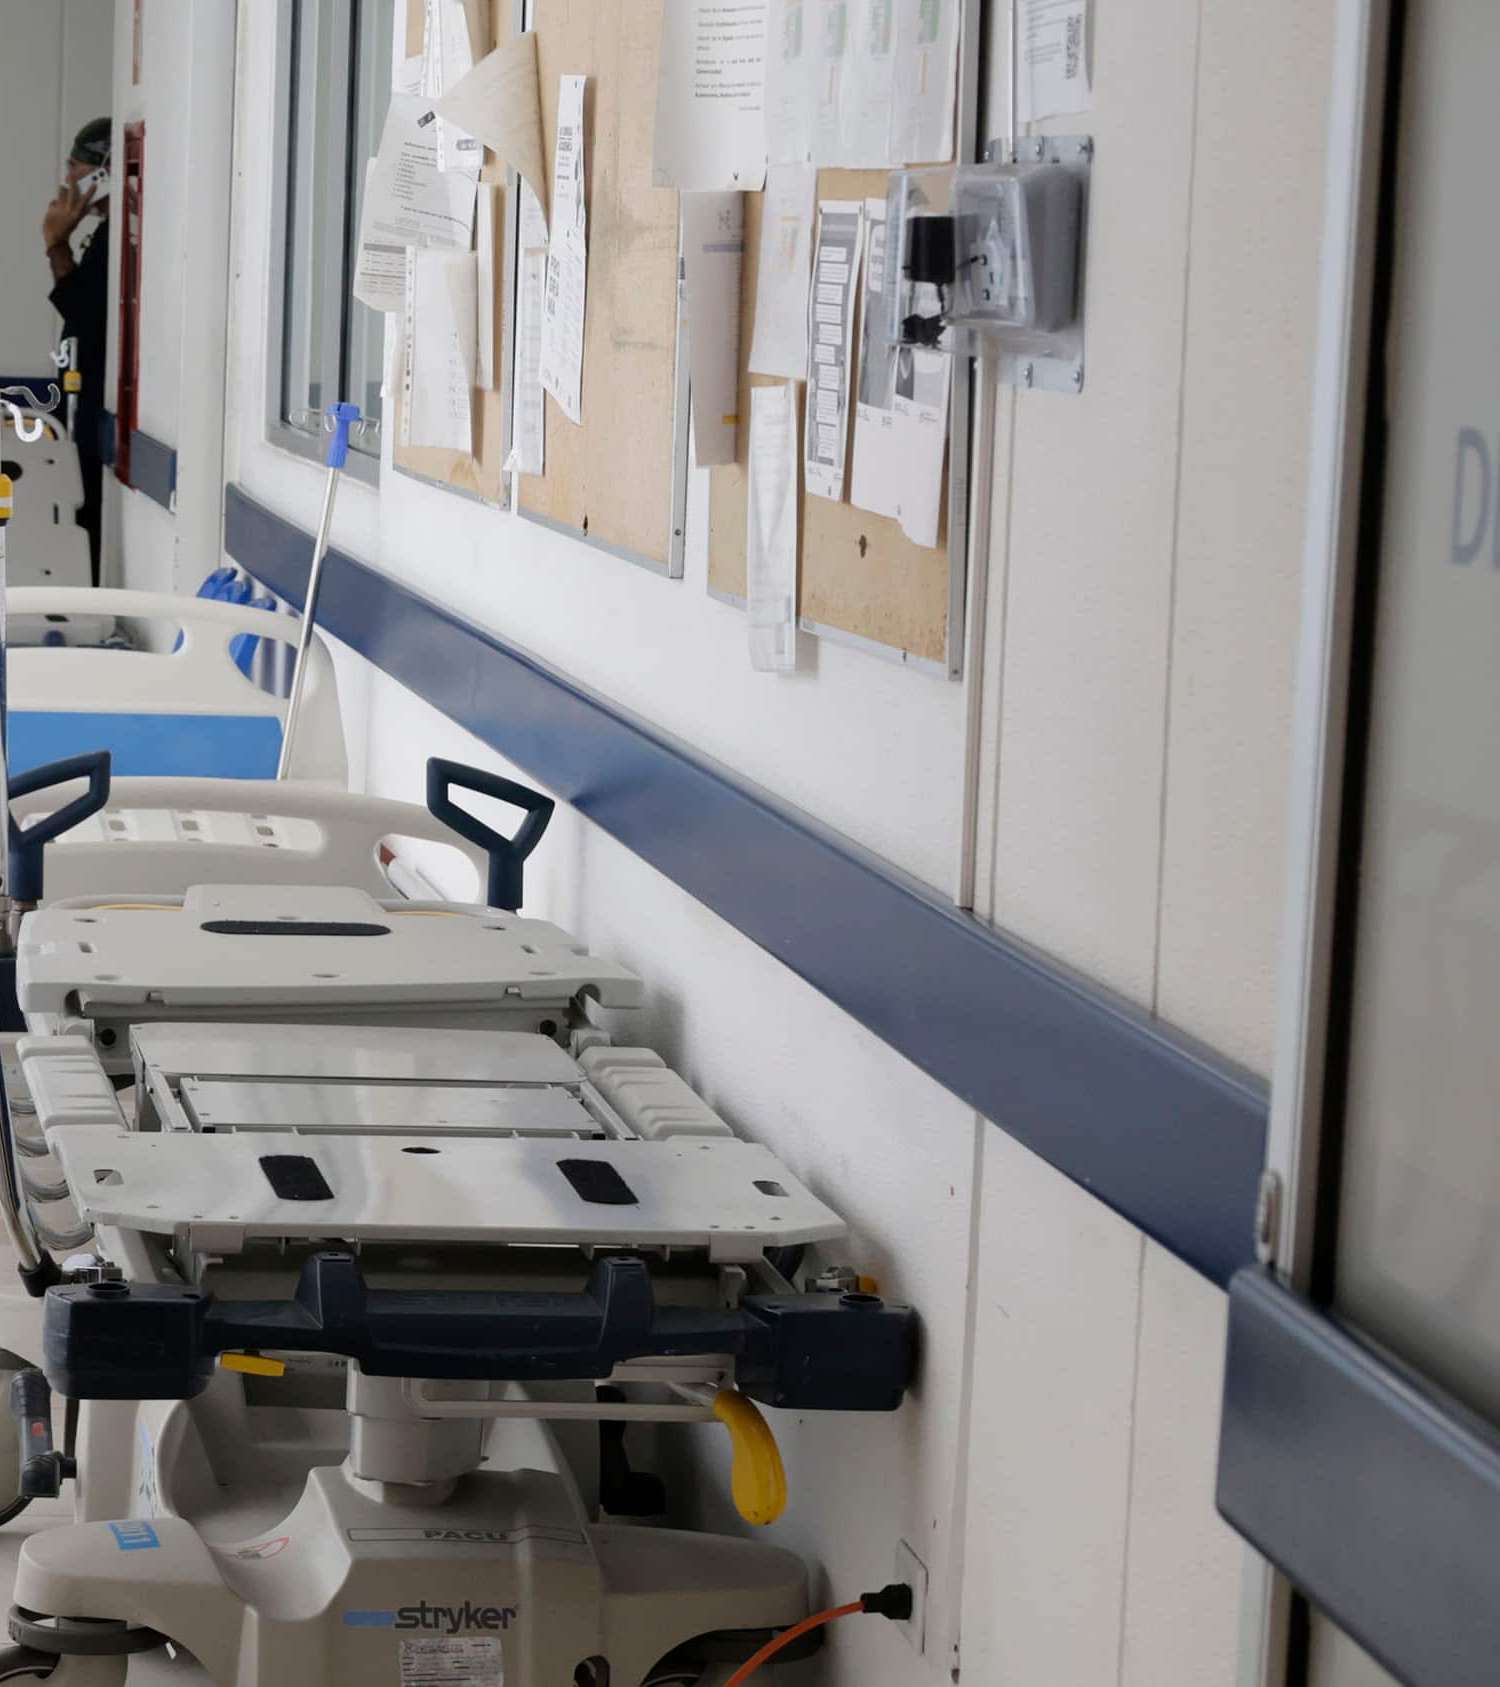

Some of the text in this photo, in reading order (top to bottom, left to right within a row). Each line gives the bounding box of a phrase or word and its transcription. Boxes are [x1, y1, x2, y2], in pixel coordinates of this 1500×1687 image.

[1451, 425, 1500, 570] D
[424, 1530, 507, 1541] PACU
[395, 1600, 516, 1634] stryker
